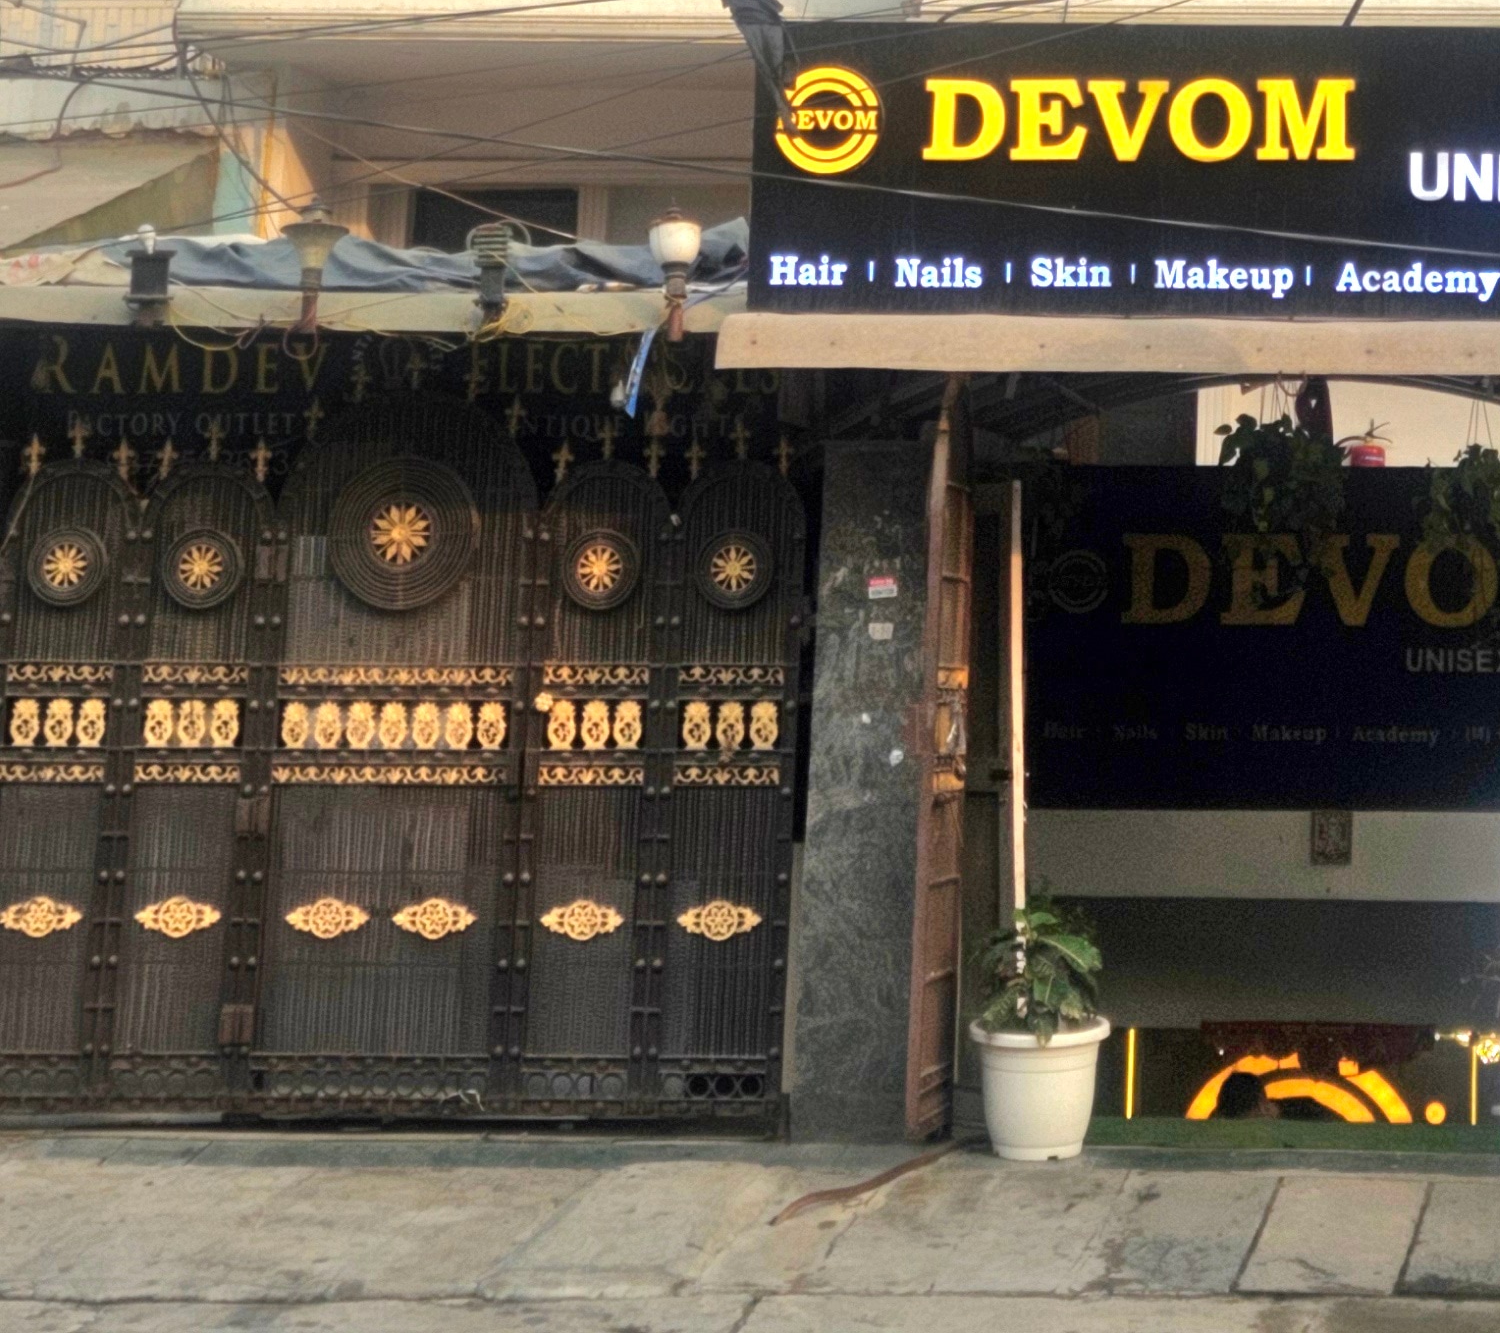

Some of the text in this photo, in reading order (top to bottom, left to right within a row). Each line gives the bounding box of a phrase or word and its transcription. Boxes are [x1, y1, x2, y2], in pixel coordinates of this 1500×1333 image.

[922, 78, 1356, 162] DEVOM
[769, 255, 849, 286] Hair
[895, 257, 983, 288] Nails
[1030, 257, 1112, 287] Skin
[1153, 259, 1294, 299] Makeup
[1335, 262, 1500, 302] Academy
